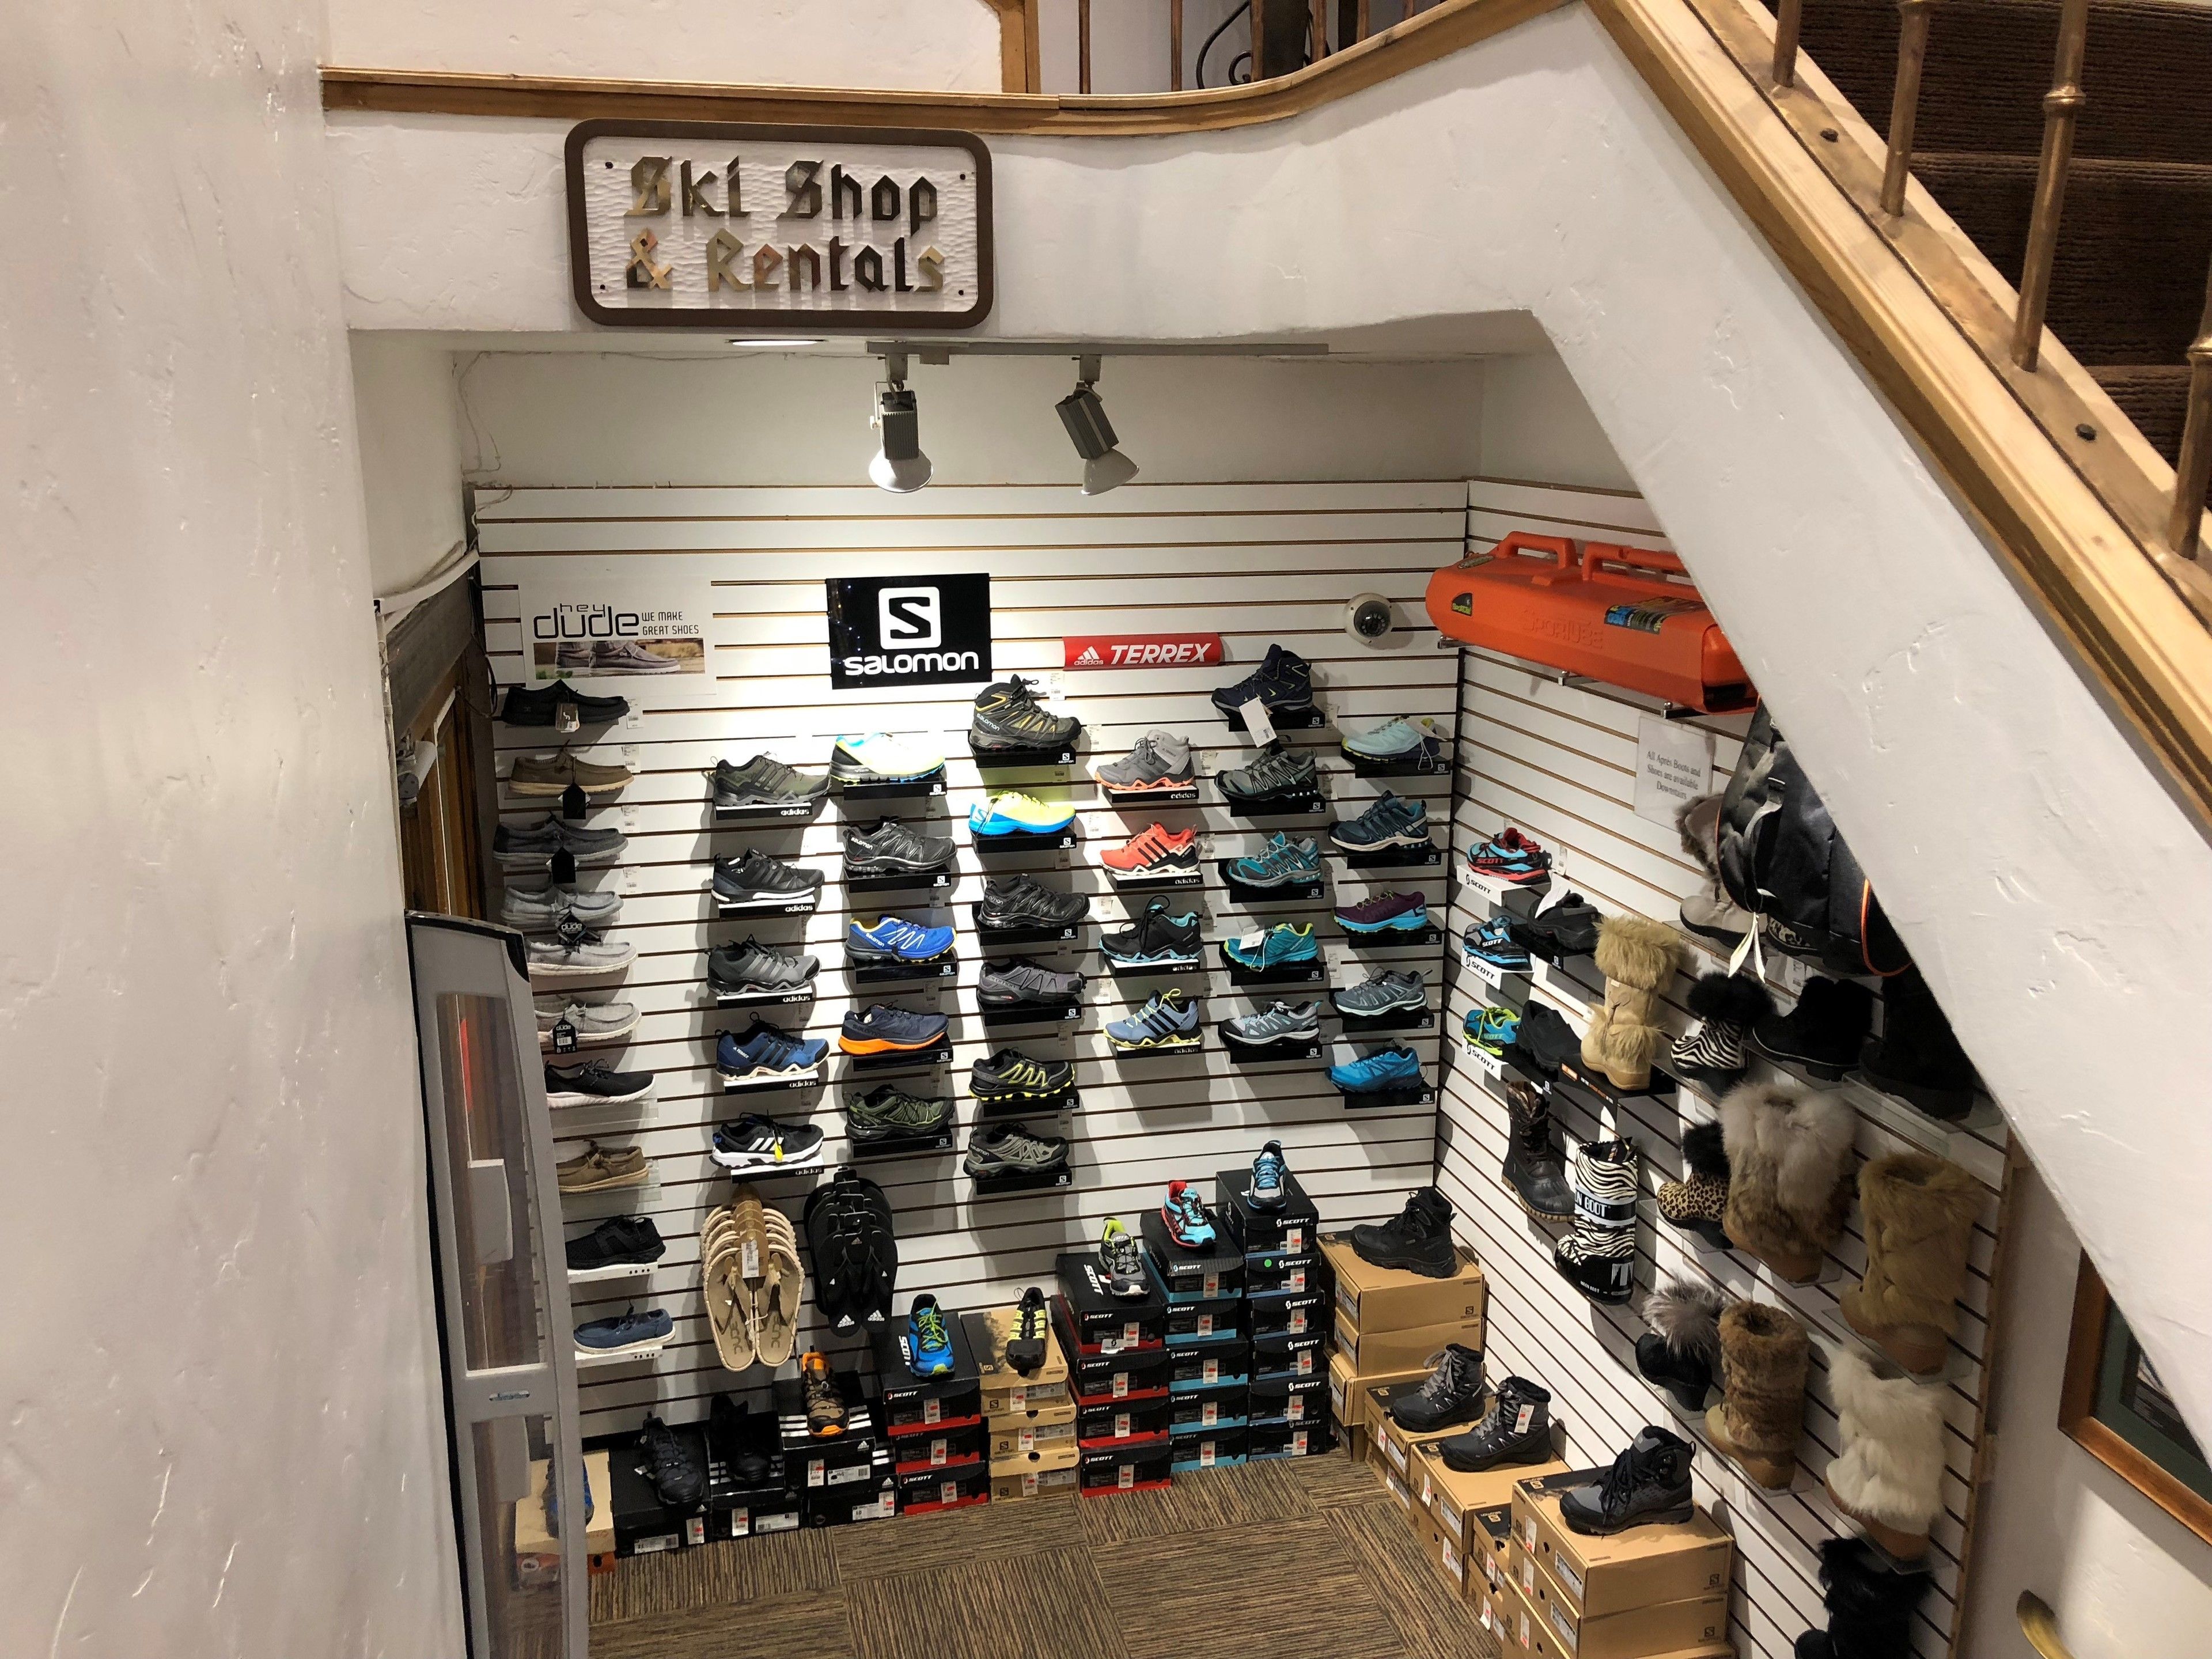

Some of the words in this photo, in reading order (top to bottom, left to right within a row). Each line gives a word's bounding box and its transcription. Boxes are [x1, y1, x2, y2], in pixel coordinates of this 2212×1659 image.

[624, 156, 751, 218] Ski
[776, 160, 938, 237] Shop
[626, 228, 672, 289] &
[706, 228, 944, 292] Rentals
[559, 603, 606, 618] hey
[642, 612, 655, 622] WE
[658, 611, 683, 621] MAKE
[533, 606, 639, 639] dude
[642, 625, 668, 635] GREAT
[672, 624, 699, 634] SHOES
[1110, 642, 1211, 665] TERREX
[1647, 751, 1655, 760] All
[1673, 759, 1689, 772] Boots
[1690, 768, 1700, 777] and
[1647, 764, 1662, 777] Shoes
[1673, 776, 1698, 790] available
[1657, 781, 1687, 800] Downstairs
[1470, 879, 1491, 894] SCOTT
[561, 922, 582, 930] dude
[1482, 938, 1503, 947] SCOTT
[1471, 961, 1495, 979] SCOTT
[1472, 1050, 1495, 1070] SCOTT
[1585, 1196, 1607, 1217] BOOT
[1084, 1264, 1104, 1296] SCOTT
[1291, 1298, 1317, 1306] SCOTT
[1294, 1339, 1320, 1347] SCOTT
[893, 1391, 918, 1399] SCOTT
[908, 1474, 933, 1482] SCOTT
